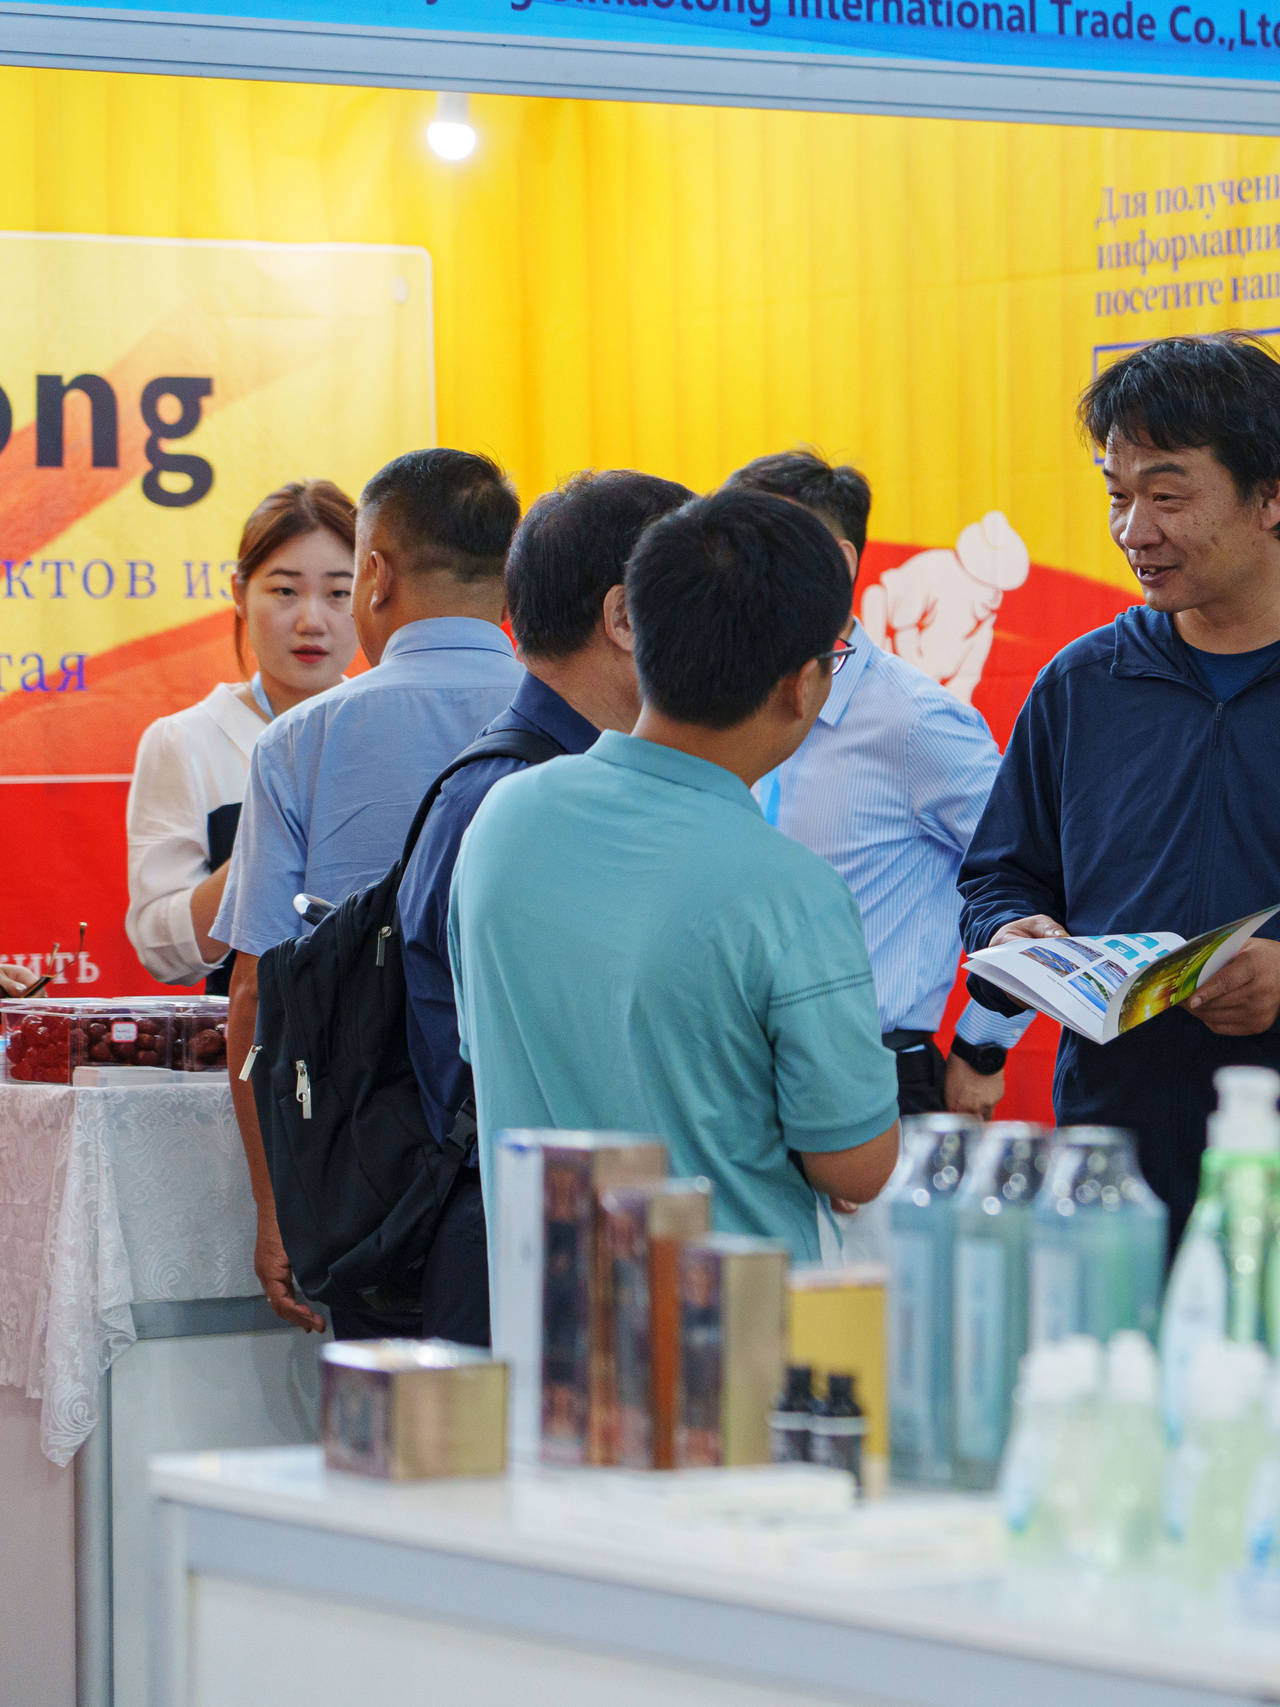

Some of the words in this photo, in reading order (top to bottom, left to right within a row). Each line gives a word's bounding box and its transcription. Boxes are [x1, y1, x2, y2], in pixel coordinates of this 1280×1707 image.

[1050, 0, 1156, 41] Trade
[1094, 186, 1148, 231] Для
[1095, 276, 1225, 318] посетите
[0, 372, 214, 508] ng
